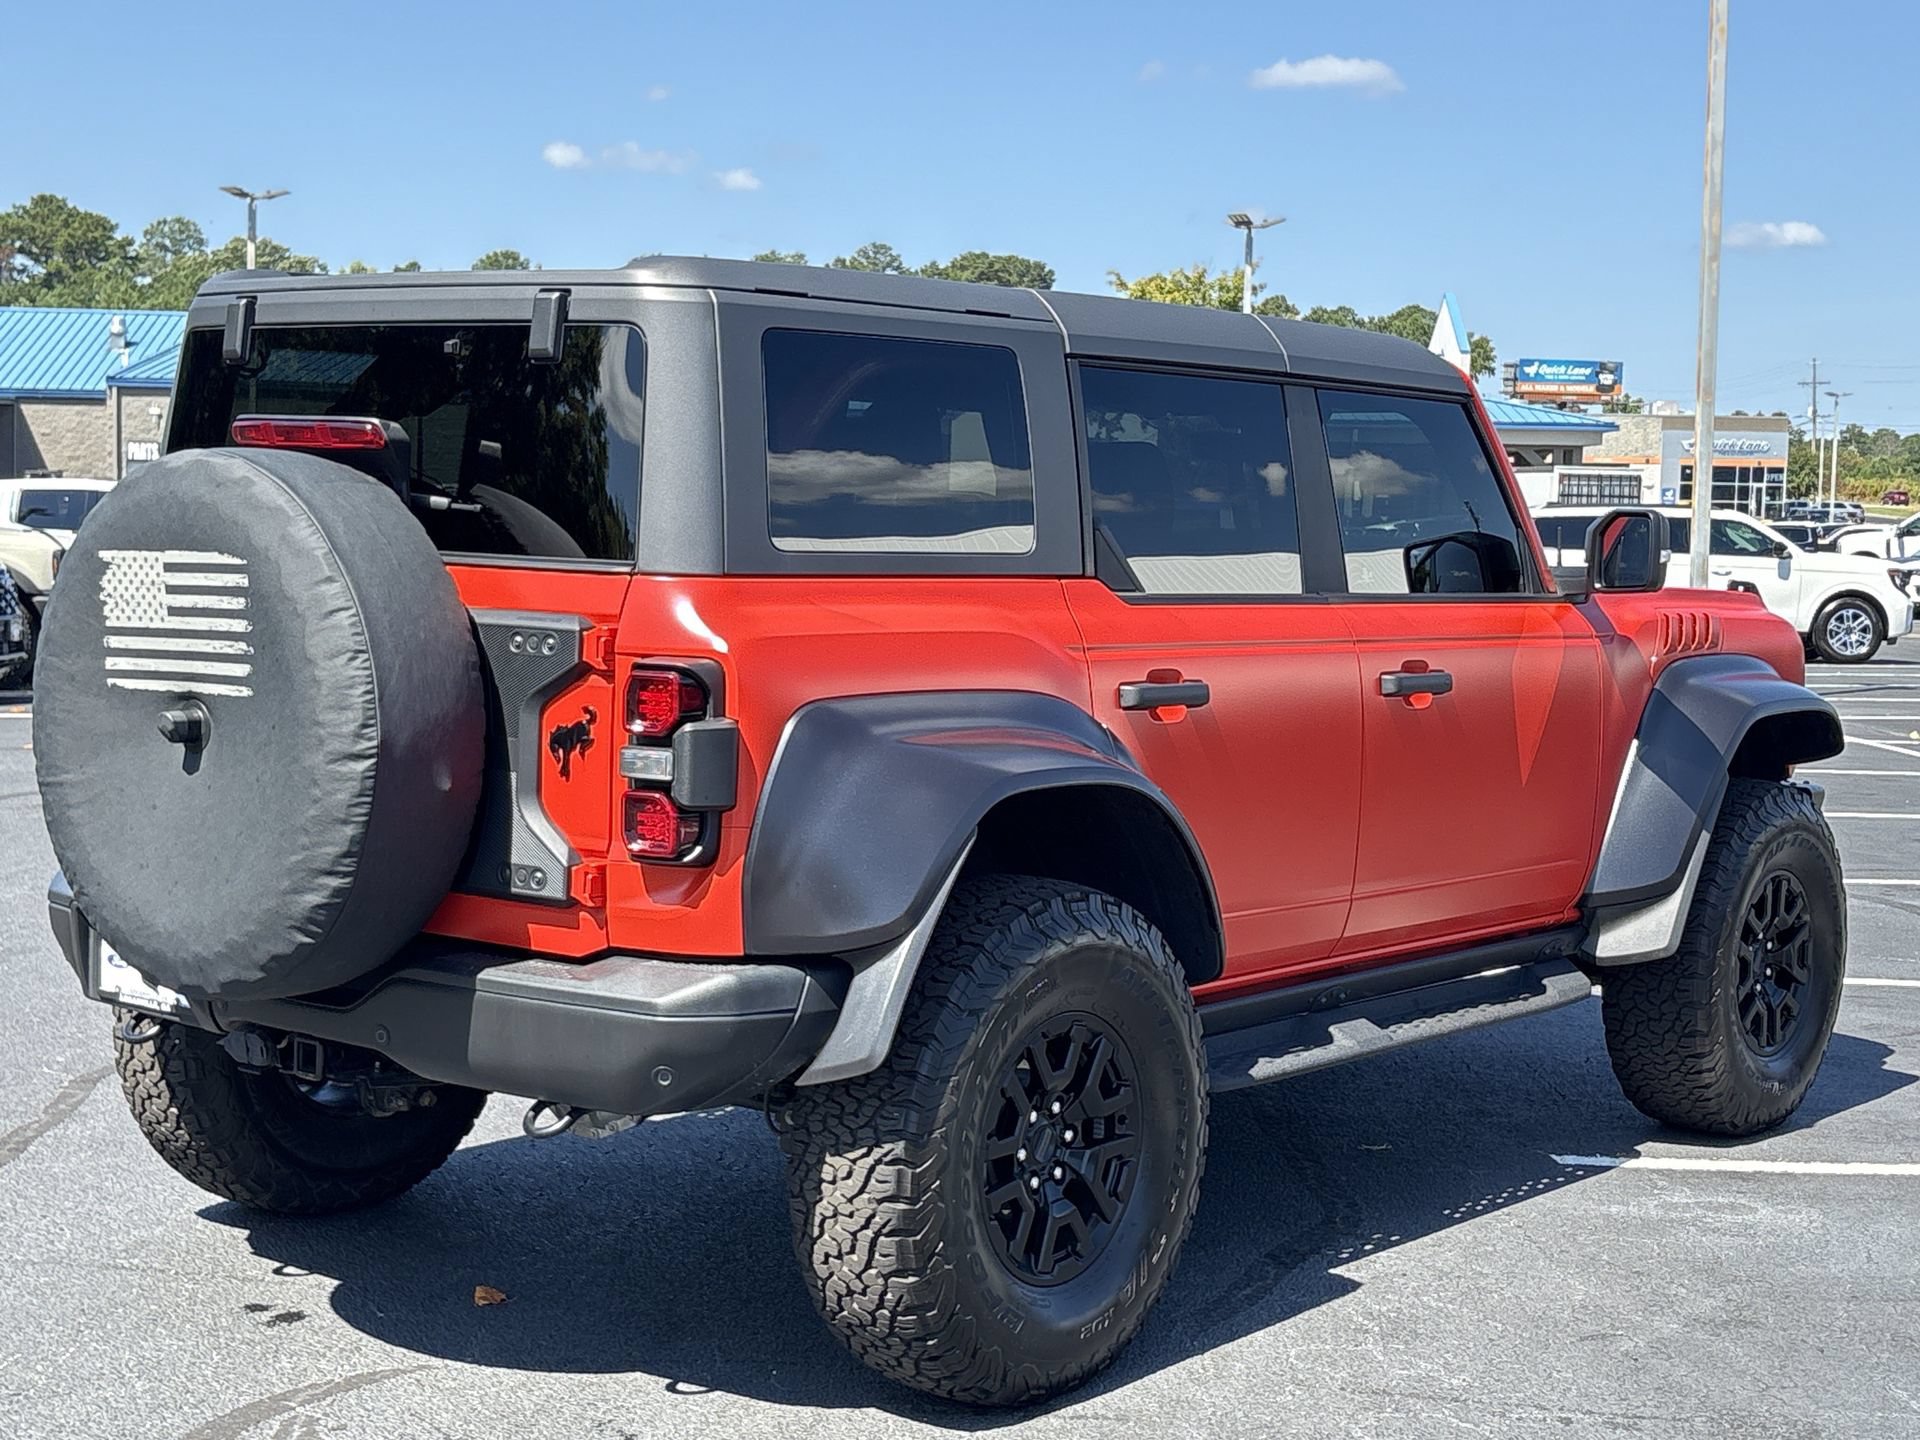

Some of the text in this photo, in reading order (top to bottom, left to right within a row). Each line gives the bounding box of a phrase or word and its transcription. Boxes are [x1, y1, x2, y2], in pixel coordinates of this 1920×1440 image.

[1538, 364, 1593, 375] Quick Lane
[128, 441, 160, 460] PARTS
[1712, 438, 1771, 452] uick Lane
